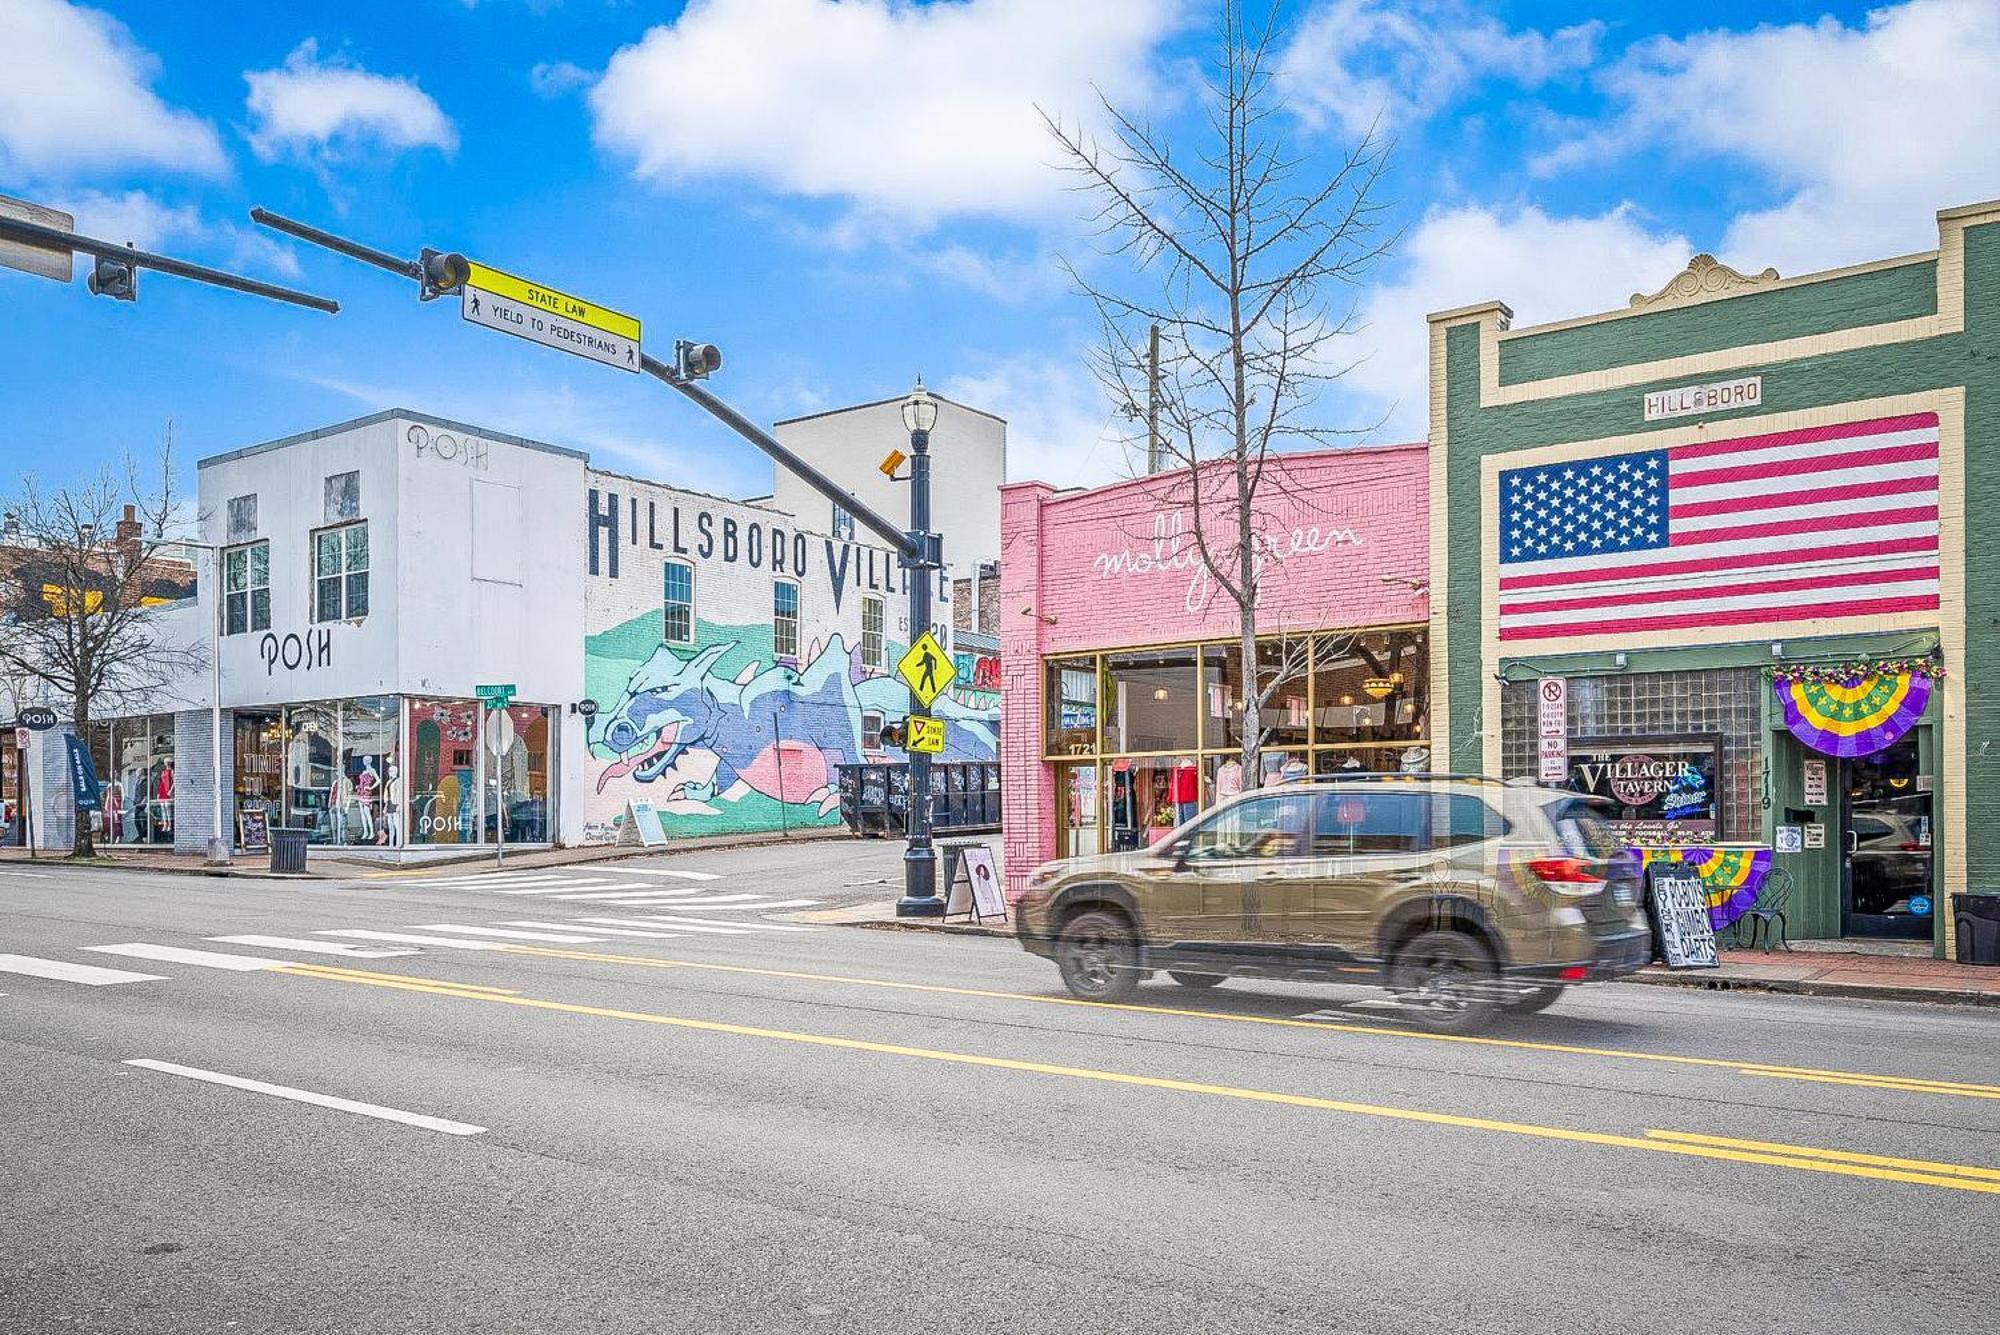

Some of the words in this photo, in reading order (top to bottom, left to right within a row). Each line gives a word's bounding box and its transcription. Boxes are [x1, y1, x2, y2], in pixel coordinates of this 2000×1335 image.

[528, 288, 559, 309] STATE
[565, 302, 586, 318] LAW
[491, 304, 524, 325] YIELD
[530, 318, 544, 331] TO
[550, 324, 617, 355] PEDESTRIANS
[1648, 382, 1757, 414] HILLSBORO
[588, 488, 807, 578] HILLSBORO
[824, 539, 949, 615] VILLE
[1093, 511, 1215, 612] molly
[260, 628, 332, 676] POSH
[22, 713, 54, 725] POSH
[1069, 742, 1096, 756] 1721
[1540, 750, 1565, 759] PARKING
[1547, 740, 1558, 749] NO
[243, 753, 281, 773] TIME
[1591, 753, 1611, 762] THE
[1574, 760, 1692, 793] VILLAGER
[1617, 779, 1674, 793] TAVERN
[419, 815, 462, 835] POSH
[1680, 936, 1716, 960] DARTS
